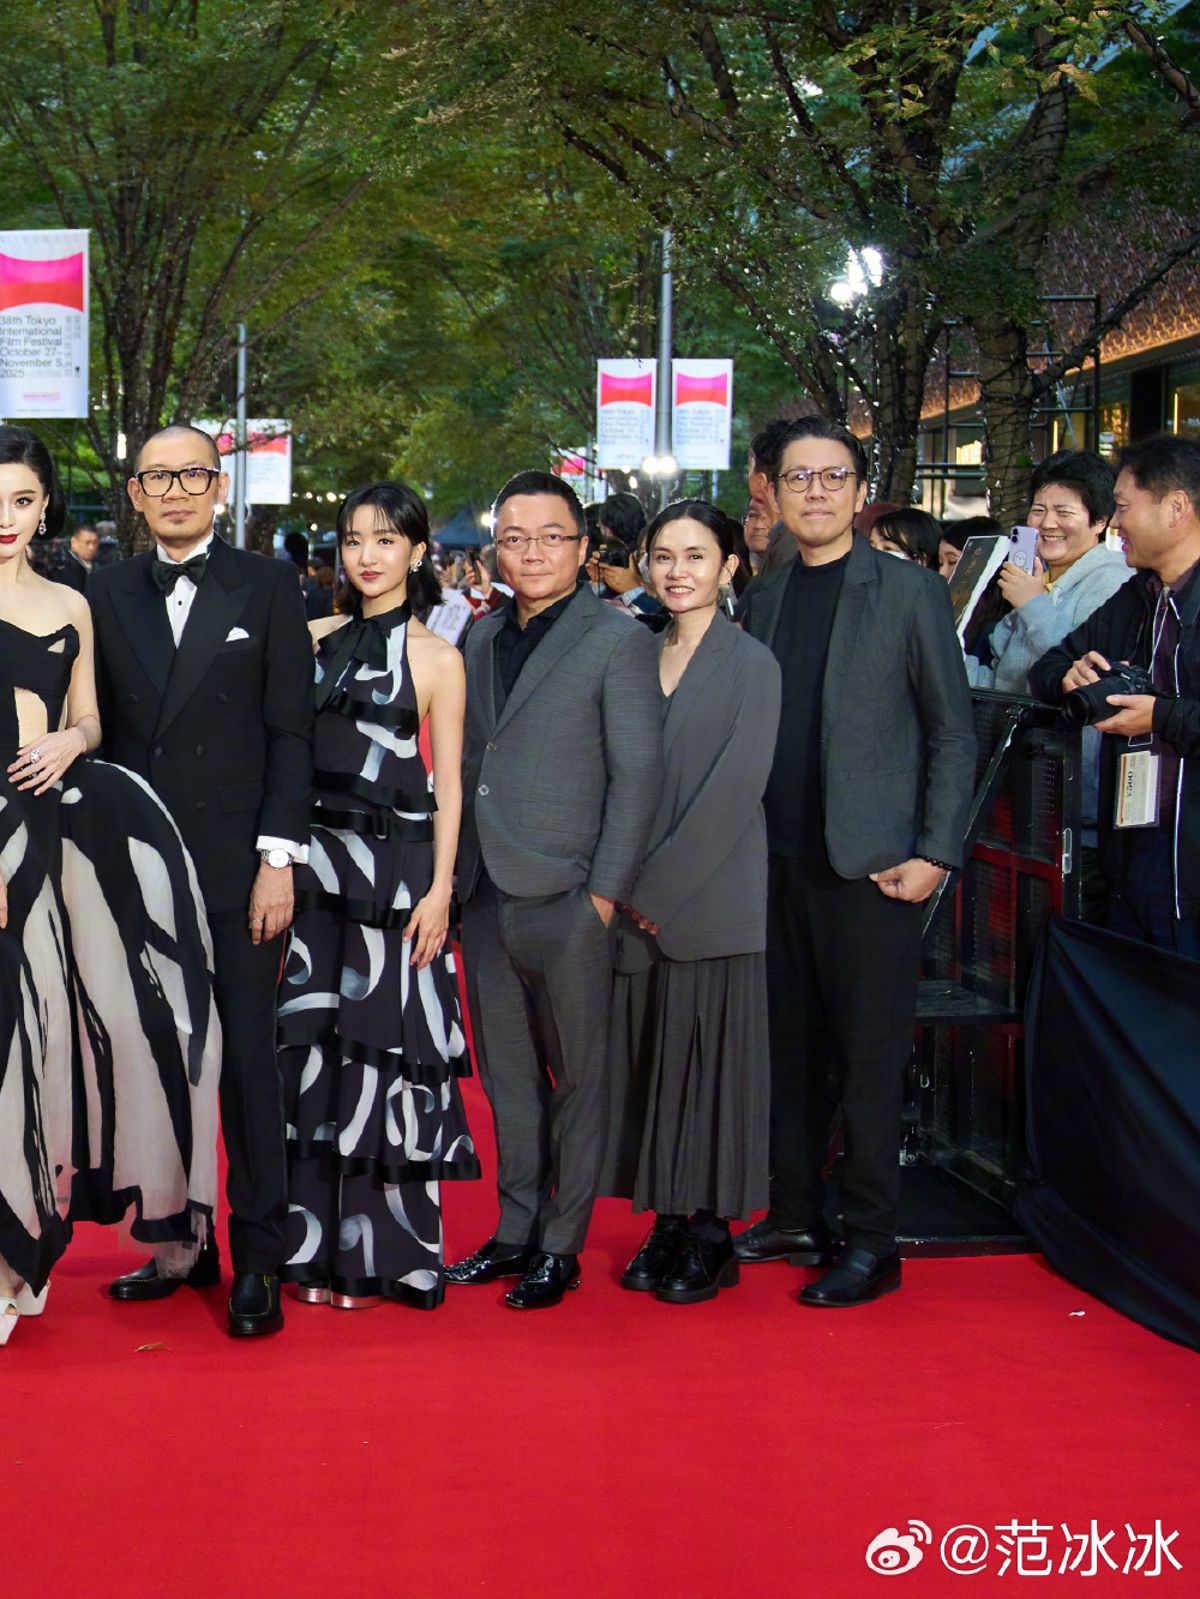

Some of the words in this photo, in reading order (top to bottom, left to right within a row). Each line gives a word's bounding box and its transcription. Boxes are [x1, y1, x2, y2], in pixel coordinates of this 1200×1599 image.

[0, 315, 22, 325] 38th
[25, 315, 56, 326] Tokyo
[0, 326, 62, 336] International
[0, 336, 21, 346] Film
[24, 336, 62, 346] Festival
[0, 347, 41, 356] October
[0, 358, 52, 367] November
[0, 368, 25, 378] 2025
